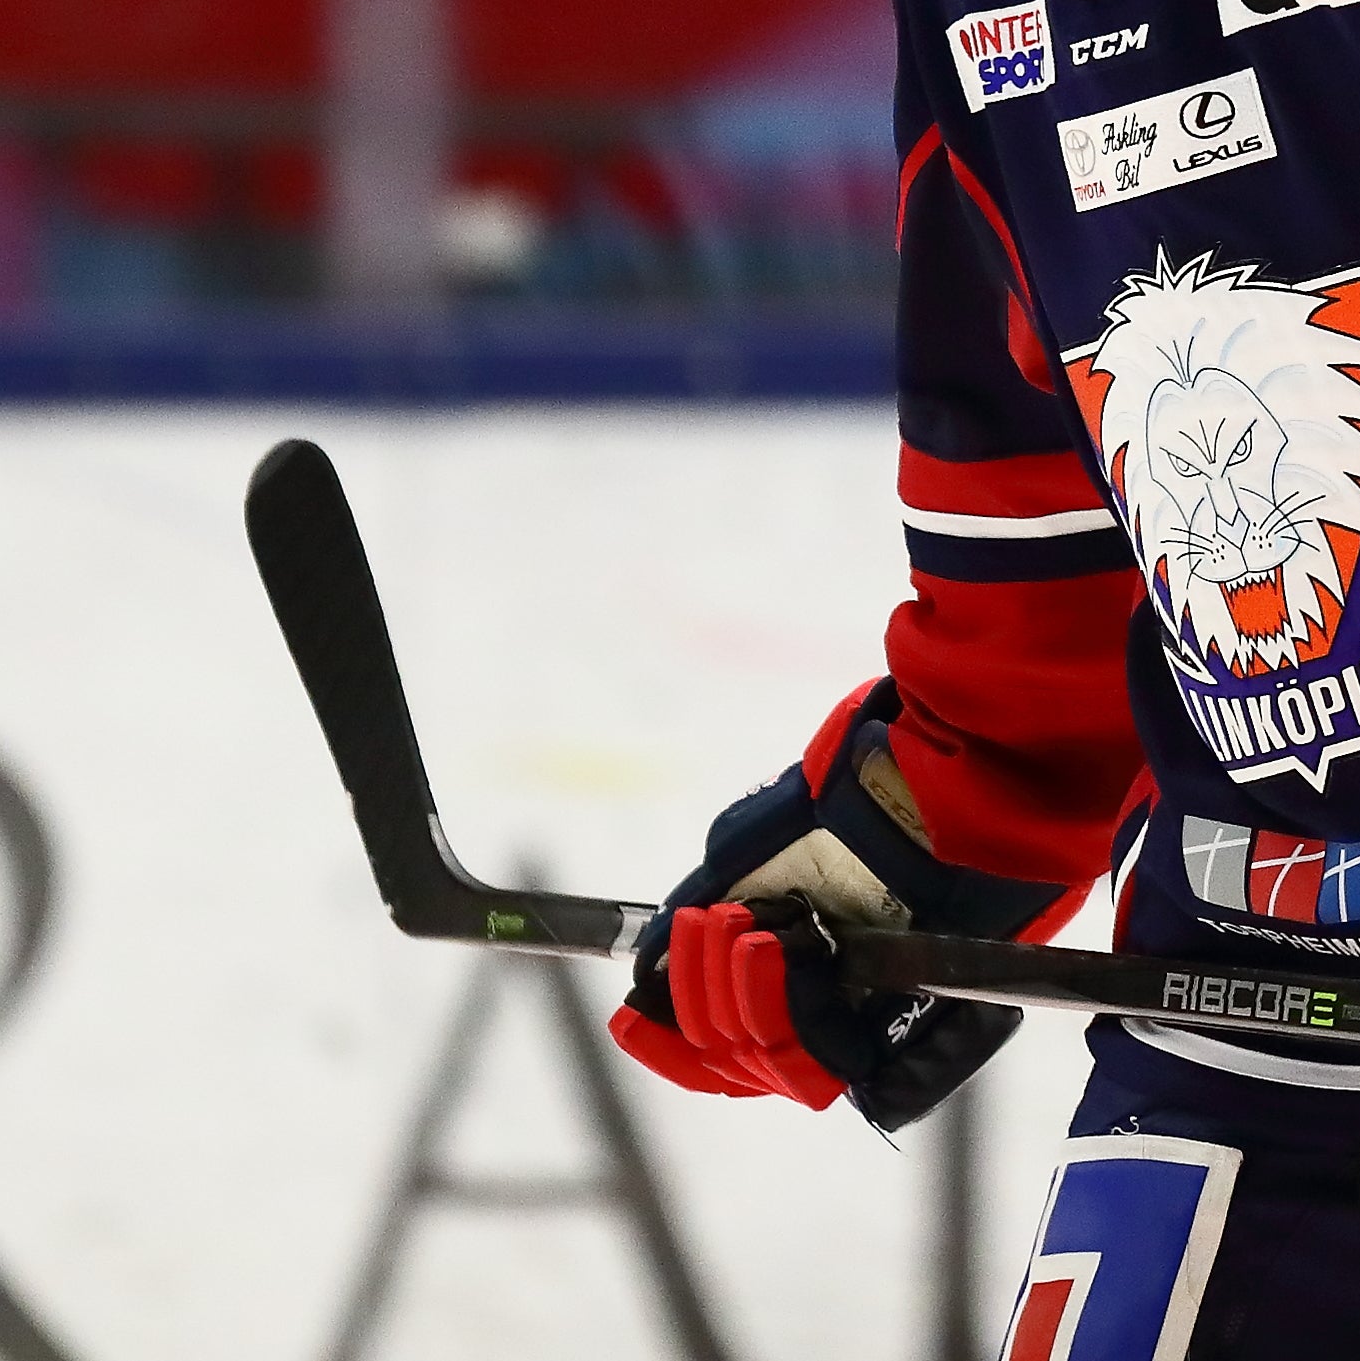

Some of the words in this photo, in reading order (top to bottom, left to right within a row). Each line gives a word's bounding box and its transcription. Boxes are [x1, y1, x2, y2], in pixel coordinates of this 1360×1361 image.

[1069, 23, 1150, 66] CCM
[978, 45, 1045, 96] SPOR
[1101, 112, 1158, 159] Askling
[1173, 135, 1263, 173] LEXUS
[1073, 180, 1106, 203] TOYOTA
[1115, 152, 1141, 192] Bil
[1162, 971, 1338, 1028] RIBCORE
